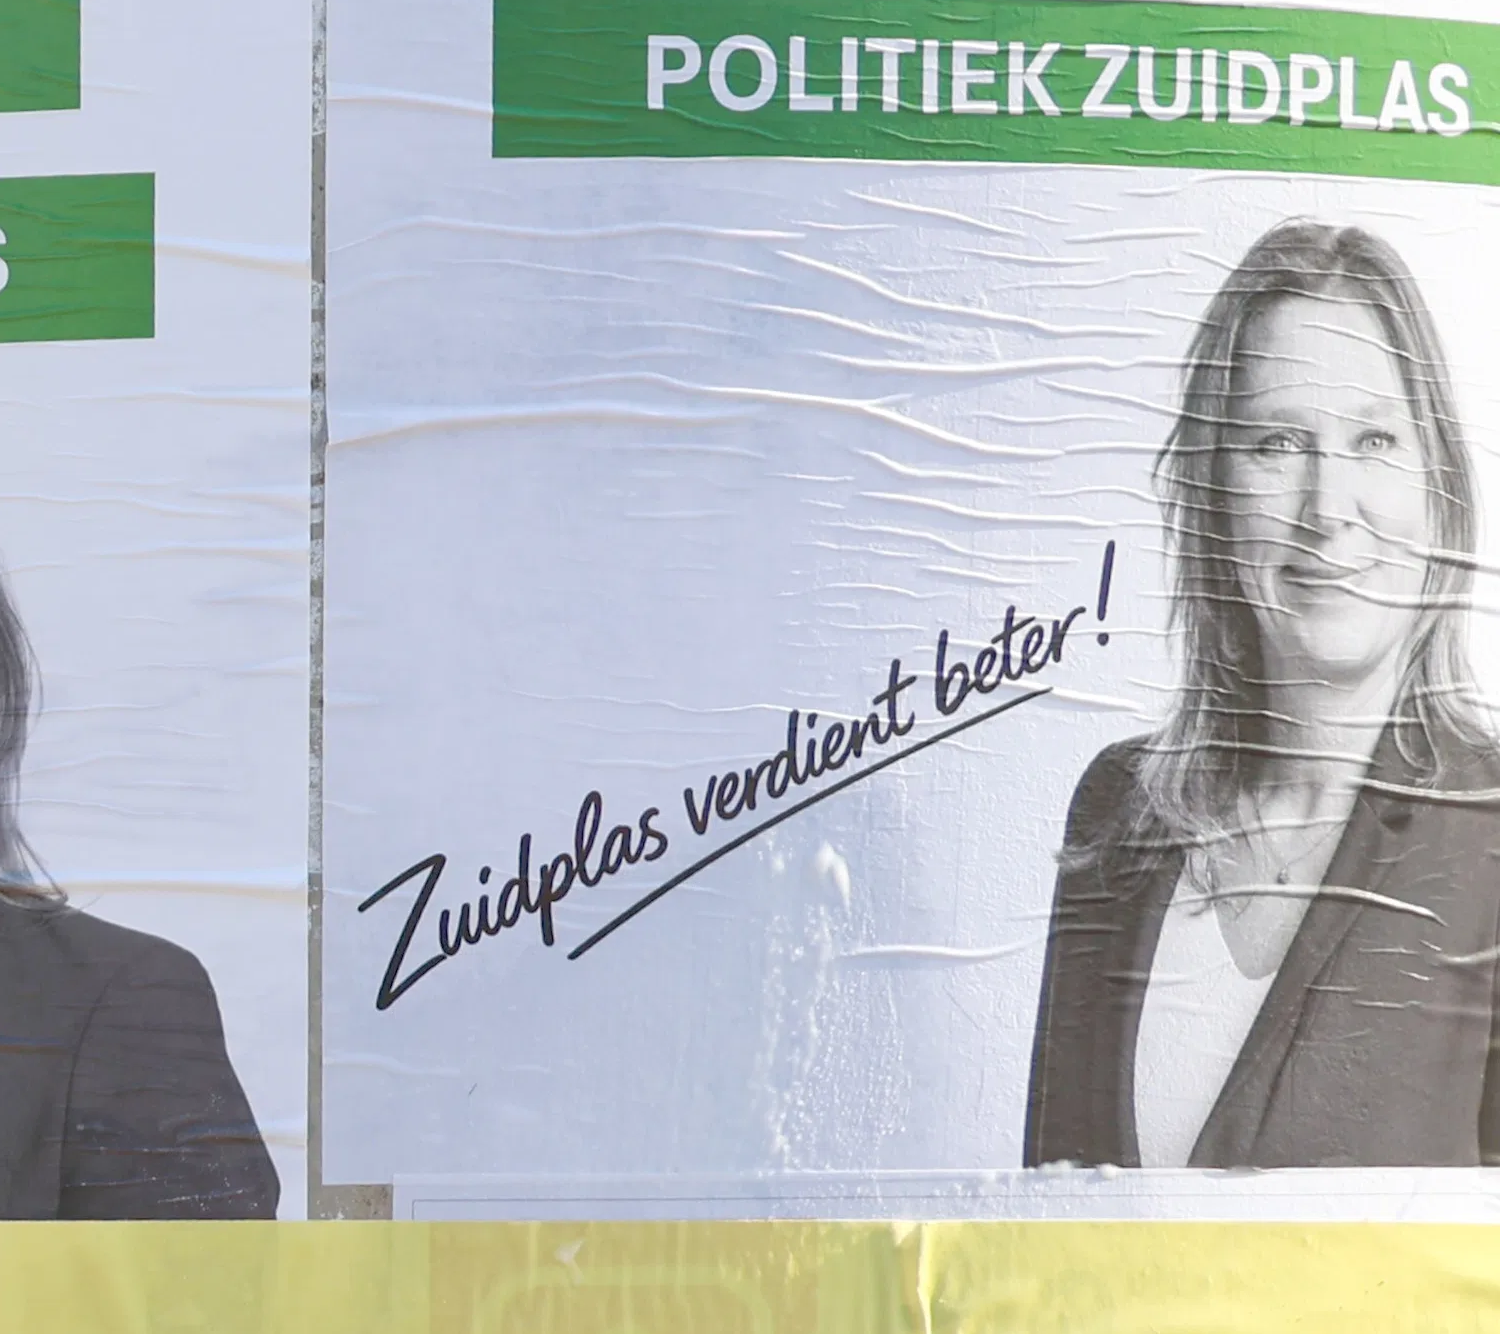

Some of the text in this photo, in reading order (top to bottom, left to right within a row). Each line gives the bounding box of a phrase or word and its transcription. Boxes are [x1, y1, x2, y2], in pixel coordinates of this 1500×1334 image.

[647, 33, 1471, 138] POLITIEK ZUIDPLAS
[358, 540, 1116, 1010] Zuidplas verdient beter!
